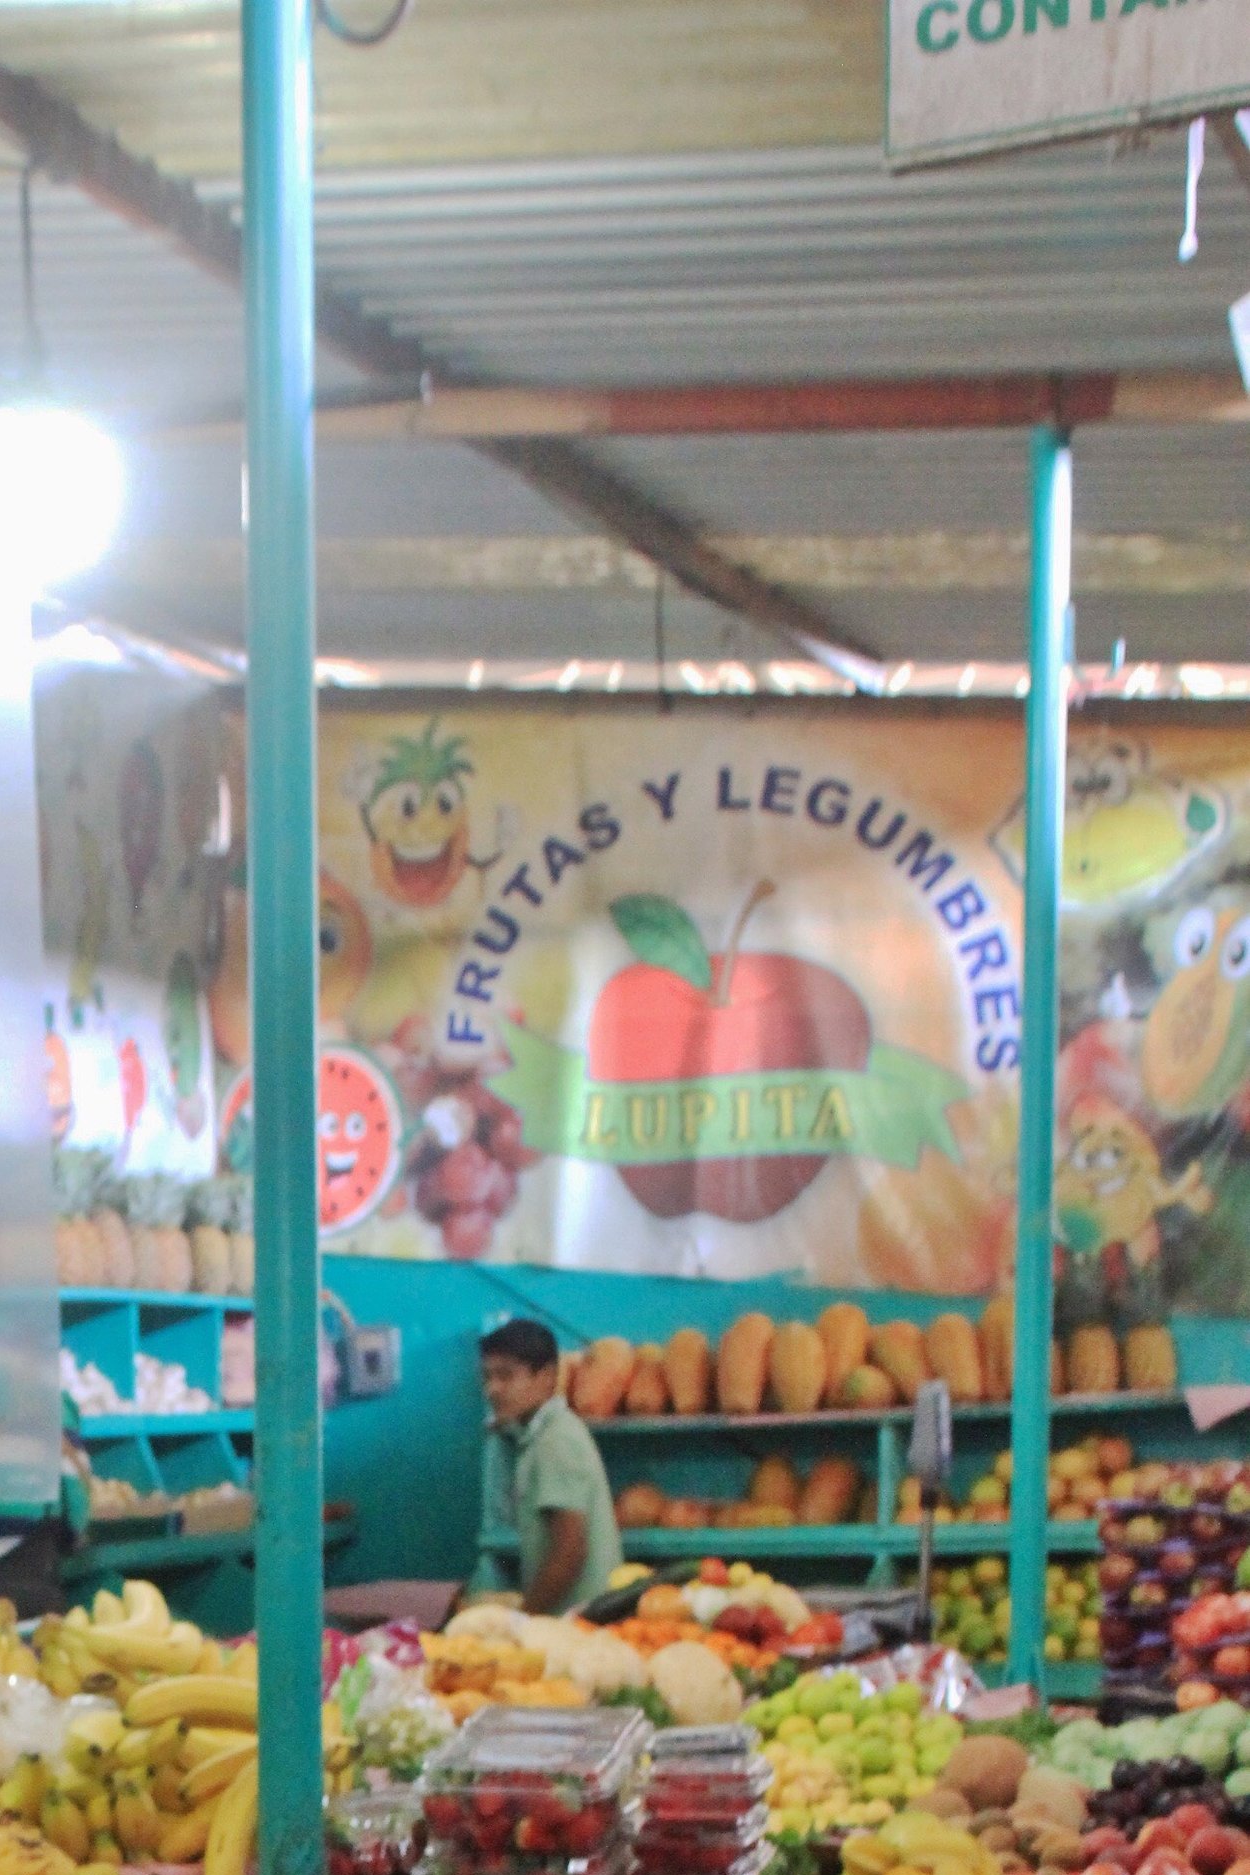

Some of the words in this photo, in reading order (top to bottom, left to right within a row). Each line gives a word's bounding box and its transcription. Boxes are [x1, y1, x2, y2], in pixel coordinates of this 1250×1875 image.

[447, 802, 621, 1044] FRUTAS
[641, 771, 681, 821] Y
[716, 766, 1021, 1072] LEGUMBRES
[583, 1084, 855, 1146] LUPITA
